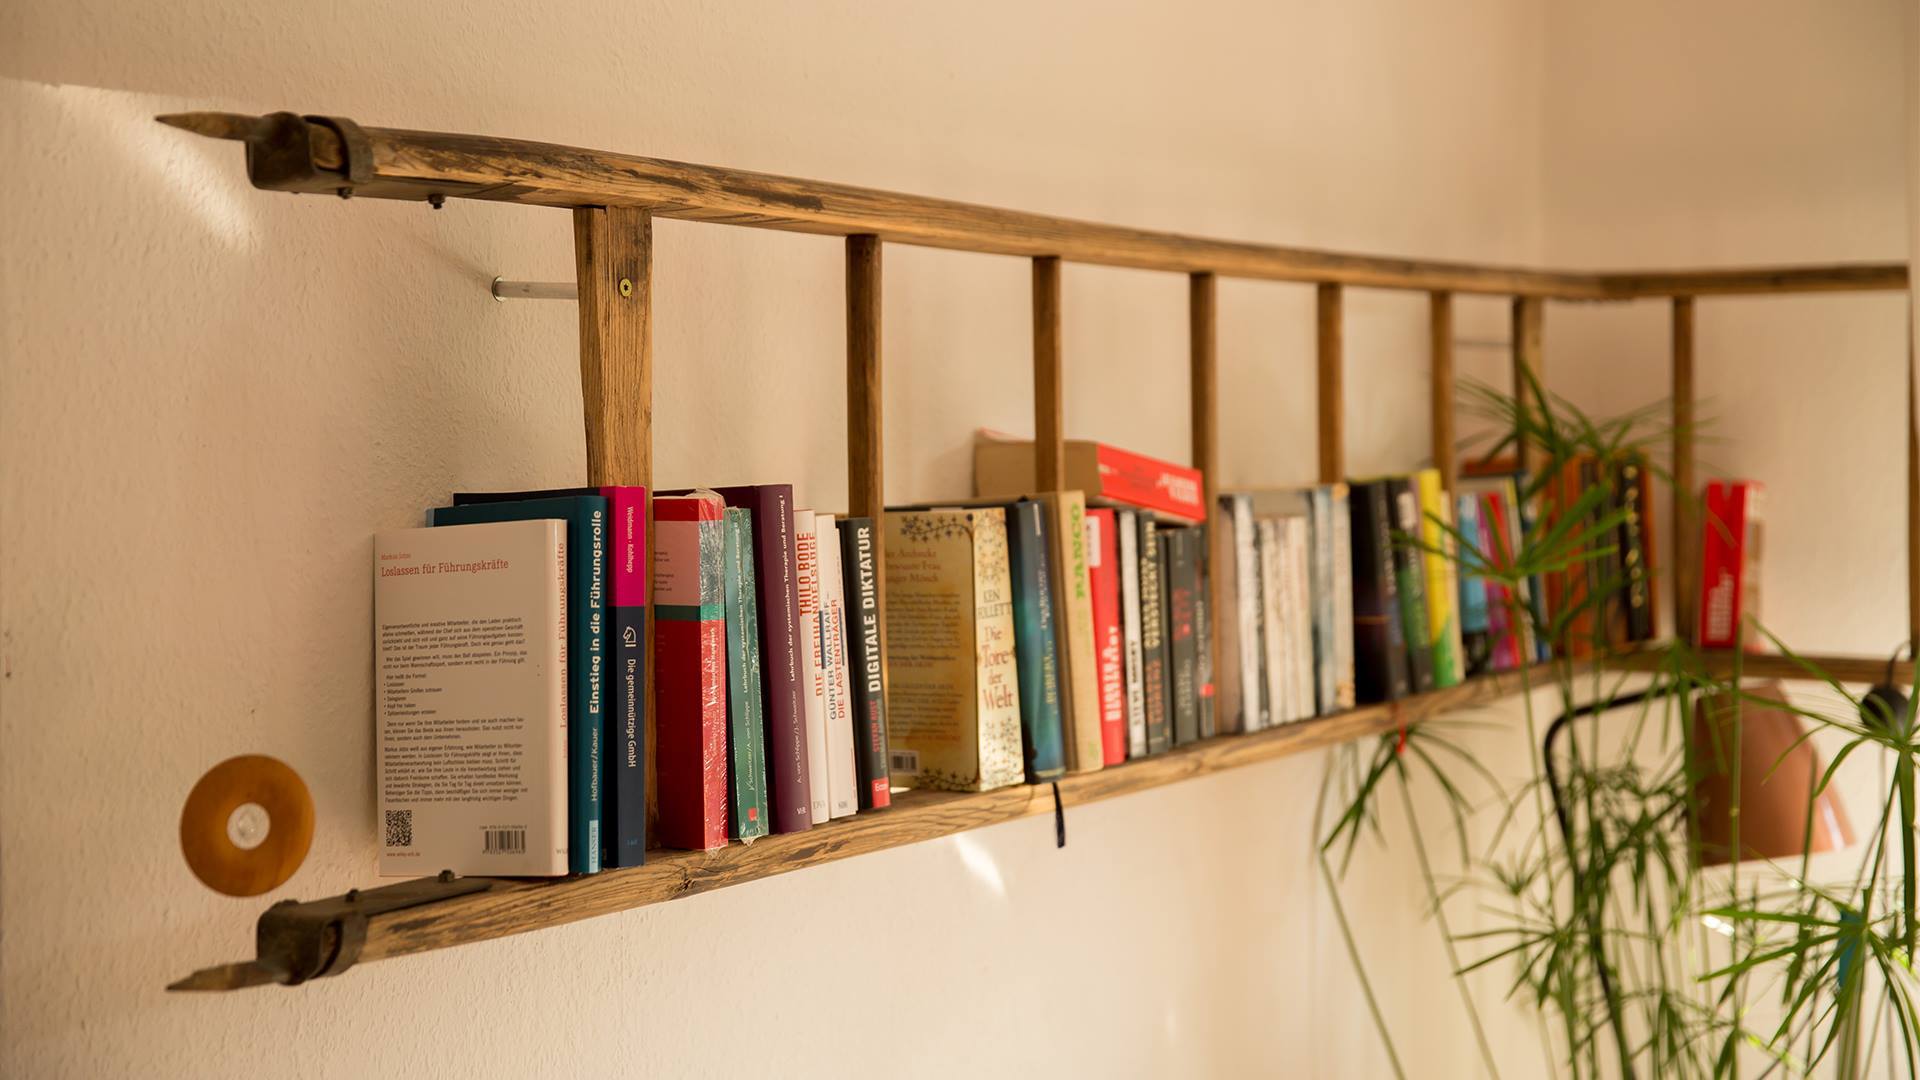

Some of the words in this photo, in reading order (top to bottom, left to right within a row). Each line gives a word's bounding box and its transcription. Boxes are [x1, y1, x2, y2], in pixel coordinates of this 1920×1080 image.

[590, 510, 602, 608] Führungsrolle
[625, 543, 634, 573] Kohlhepp
[798, 533, 809, 571] BODE
[381, 565, 420, 577] Loslassen
[422, 563, 436, 574] für
[439, 558, 509, 573] Führungskräfte
[857, 527, 875, 610] DIKTATUR
[557, 543, 566, 640] Führungskräfte
[799, 576, 810, 617] THILO
[983, 589, 1000, 602] KEN
[785, 584, 793, 632] systemischen
[590, 613, 601, 634] die
[984, 626, 1002, 641] Die
[590, 638, 600, 651] in
[831, 600, 843, 695] LASTENTRÄGER
[864, 614, 881, 692] DIGITALE
[981, 644, 1009, 668] Tore
[627, 659, 636, 674] Die
[987, 670, 1003, 684] der
[589, 655, 601, 714] Einstieg
[815, 673, 823, 696] DIE
[983, 683, 1014, 711] Welt
[625, 675, 636, 739] gemeinnützige
[837, 699, 845, 718] DIE
[868, 700, 877, 721] AUST
[871, 722, 880, 752] STEFAN
[590, 727, 599, 801] Hofbauer/Kauer
[627, 741, 637, 767] GmbH
